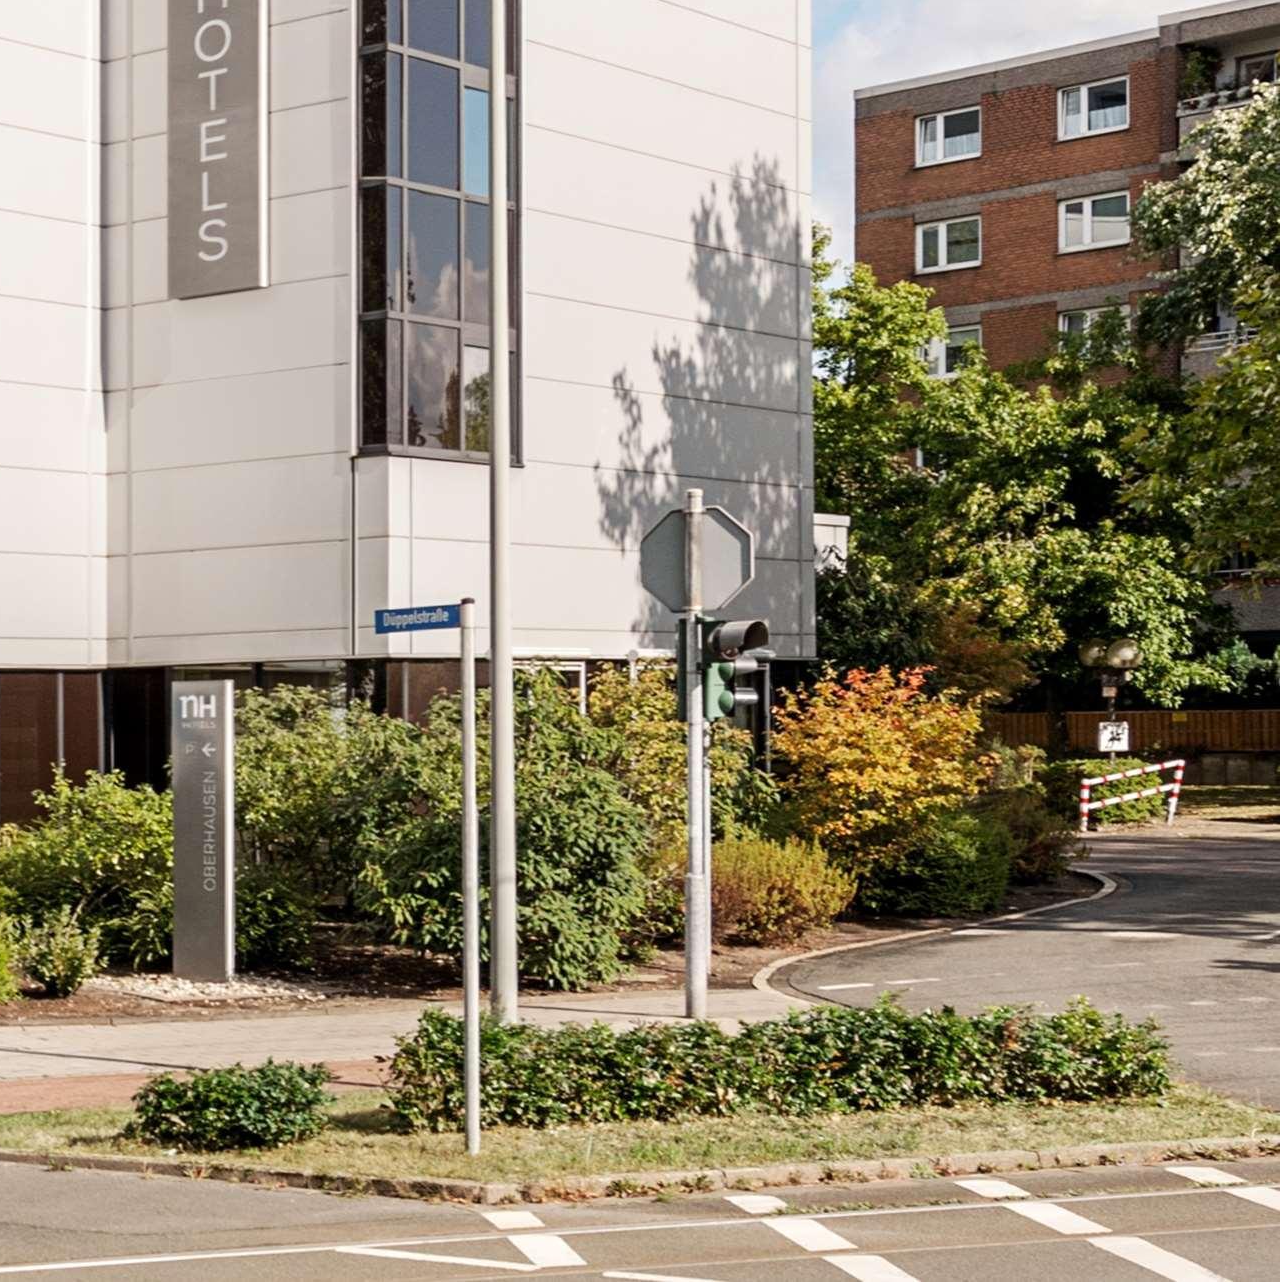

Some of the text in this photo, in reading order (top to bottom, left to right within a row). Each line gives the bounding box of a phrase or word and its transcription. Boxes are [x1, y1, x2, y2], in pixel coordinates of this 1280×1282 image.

[383, 608, 449, 629] Düppelstraße
[182, 720, 216, 729] HELS
[203, 770, 217, 892] OBERHAUSEN
